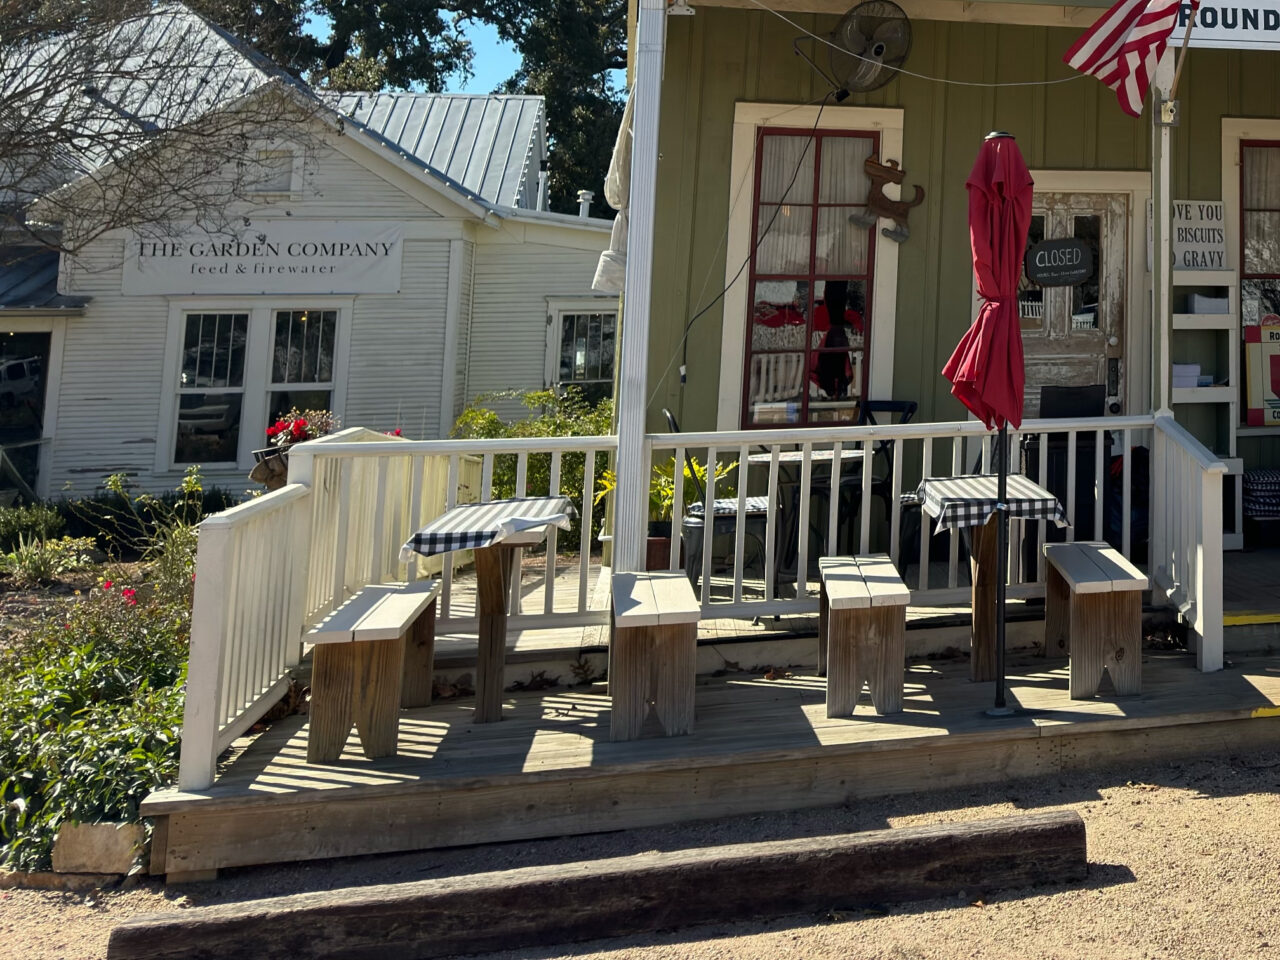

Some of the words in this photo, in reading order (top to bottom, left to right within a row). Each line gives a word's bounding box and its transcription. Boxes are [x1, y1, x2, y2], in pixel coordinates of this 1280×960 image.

[1178, 3, 1280, 31] ROUND
[1198, 204, 1222, 221] YOU
[1177, 227, 1224, 244] BISCUITS
[137, 241, 183, 257] THE
[189, 241, 280, 257] GARDEN
[287, 241, 394, 257] COMPANY
[1035, 247, 1081, 267] CLOSED
[1183, 250, 1224, 268] GRAVY
[190, 263, 229, 275] feed
[235, 263, 247, 275] &
[253, 262, 337, 275] firewater
